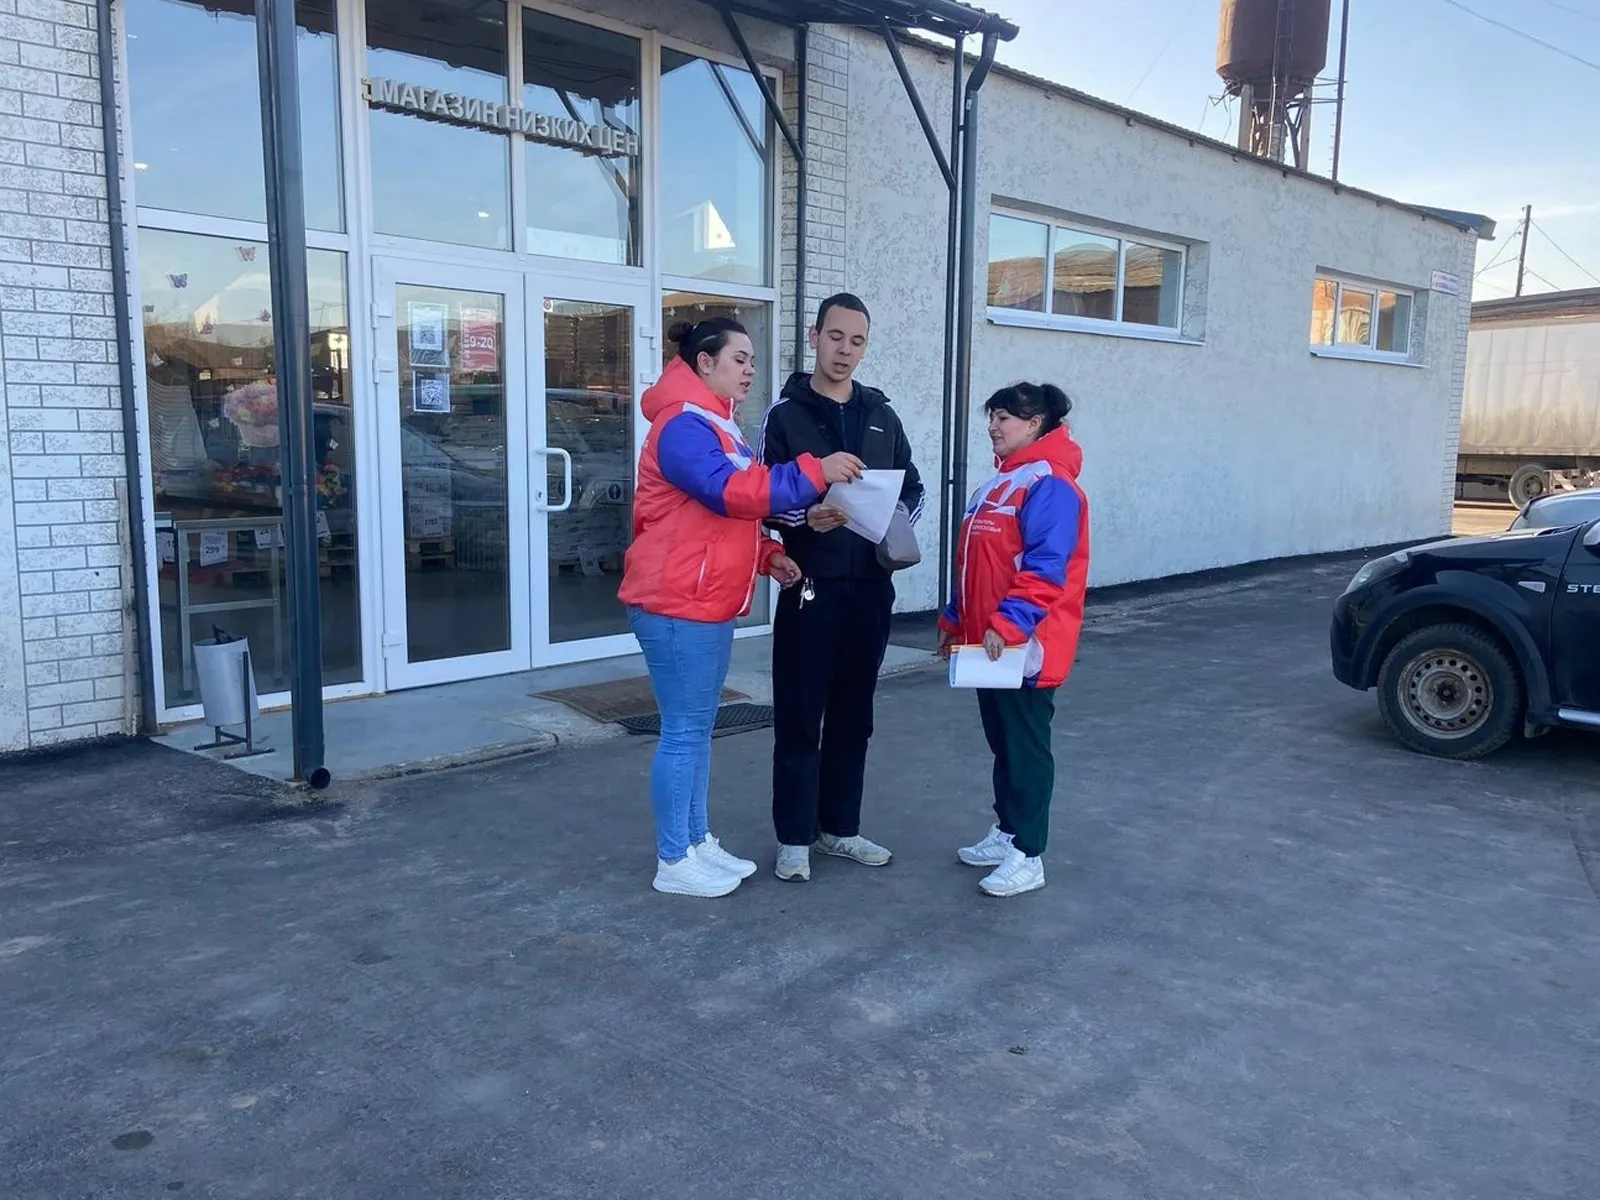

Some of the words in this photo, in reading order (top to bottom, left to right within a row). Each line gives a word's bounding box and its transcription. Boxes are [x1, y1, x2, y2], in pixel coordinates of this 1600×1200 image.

[379, 78, 498, 127] МАГАЗИН
[505, 107, 594, 146] НИЗКИХ
[598, 126, 640, 156] ЦЕН
[469, 335, 493, 349] 9-20
